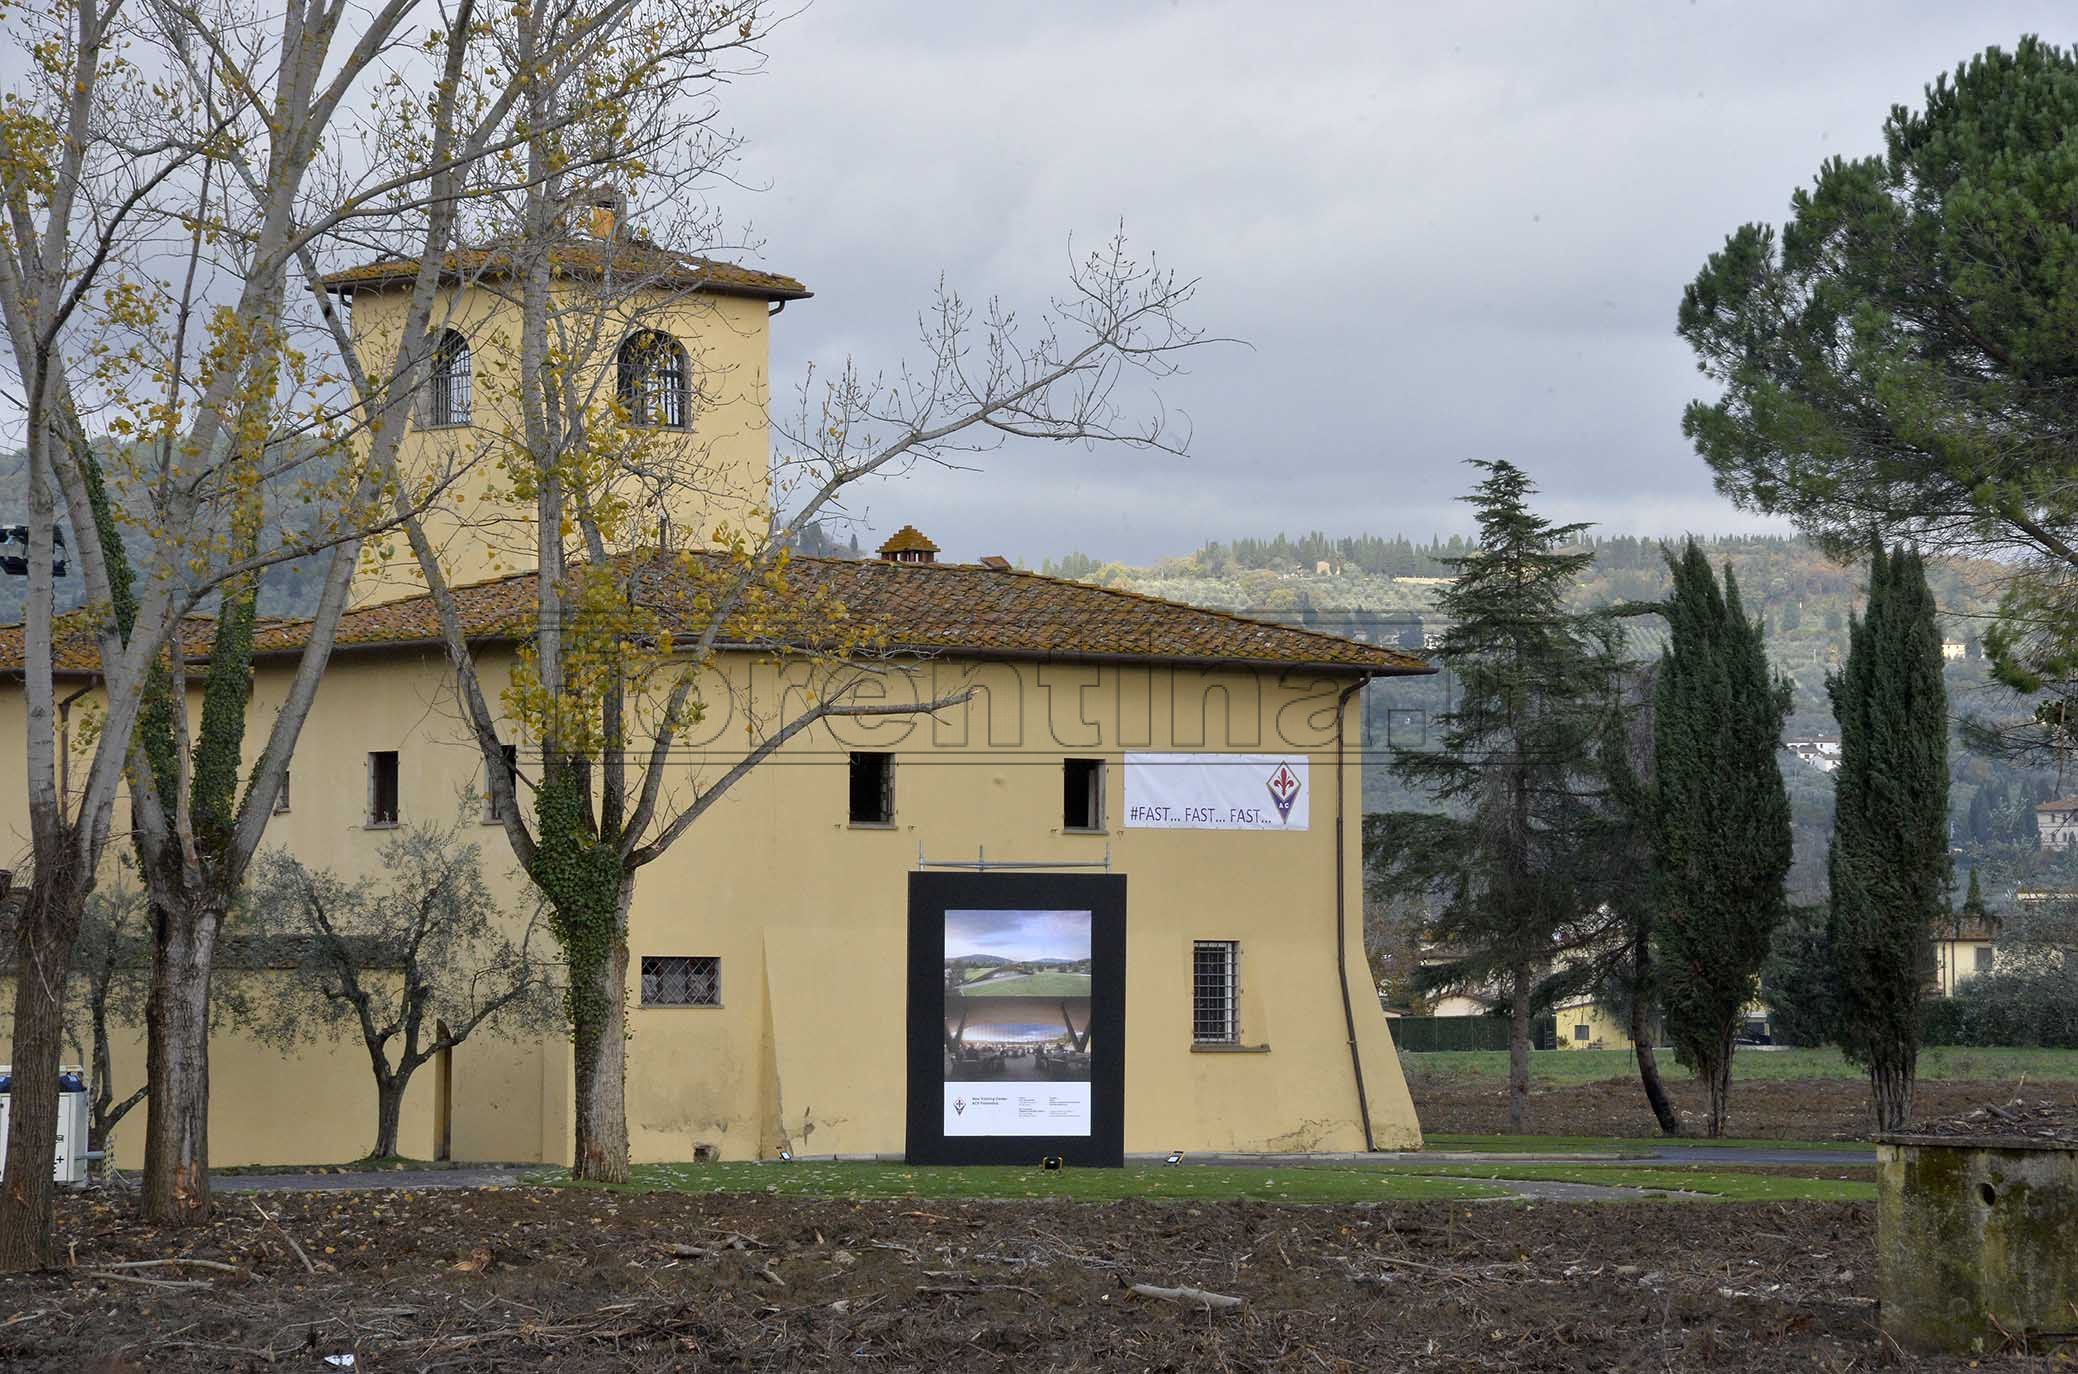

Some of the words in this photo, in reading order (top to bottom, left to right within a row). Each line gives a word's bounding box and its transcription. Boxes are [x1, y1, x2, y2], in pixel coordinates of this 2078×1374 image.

[1130, 806, 1181, 822] #FAST...
[1185, 807, 1225, 823] FAST...
[1230, 808, 1272, 824] FAST...
